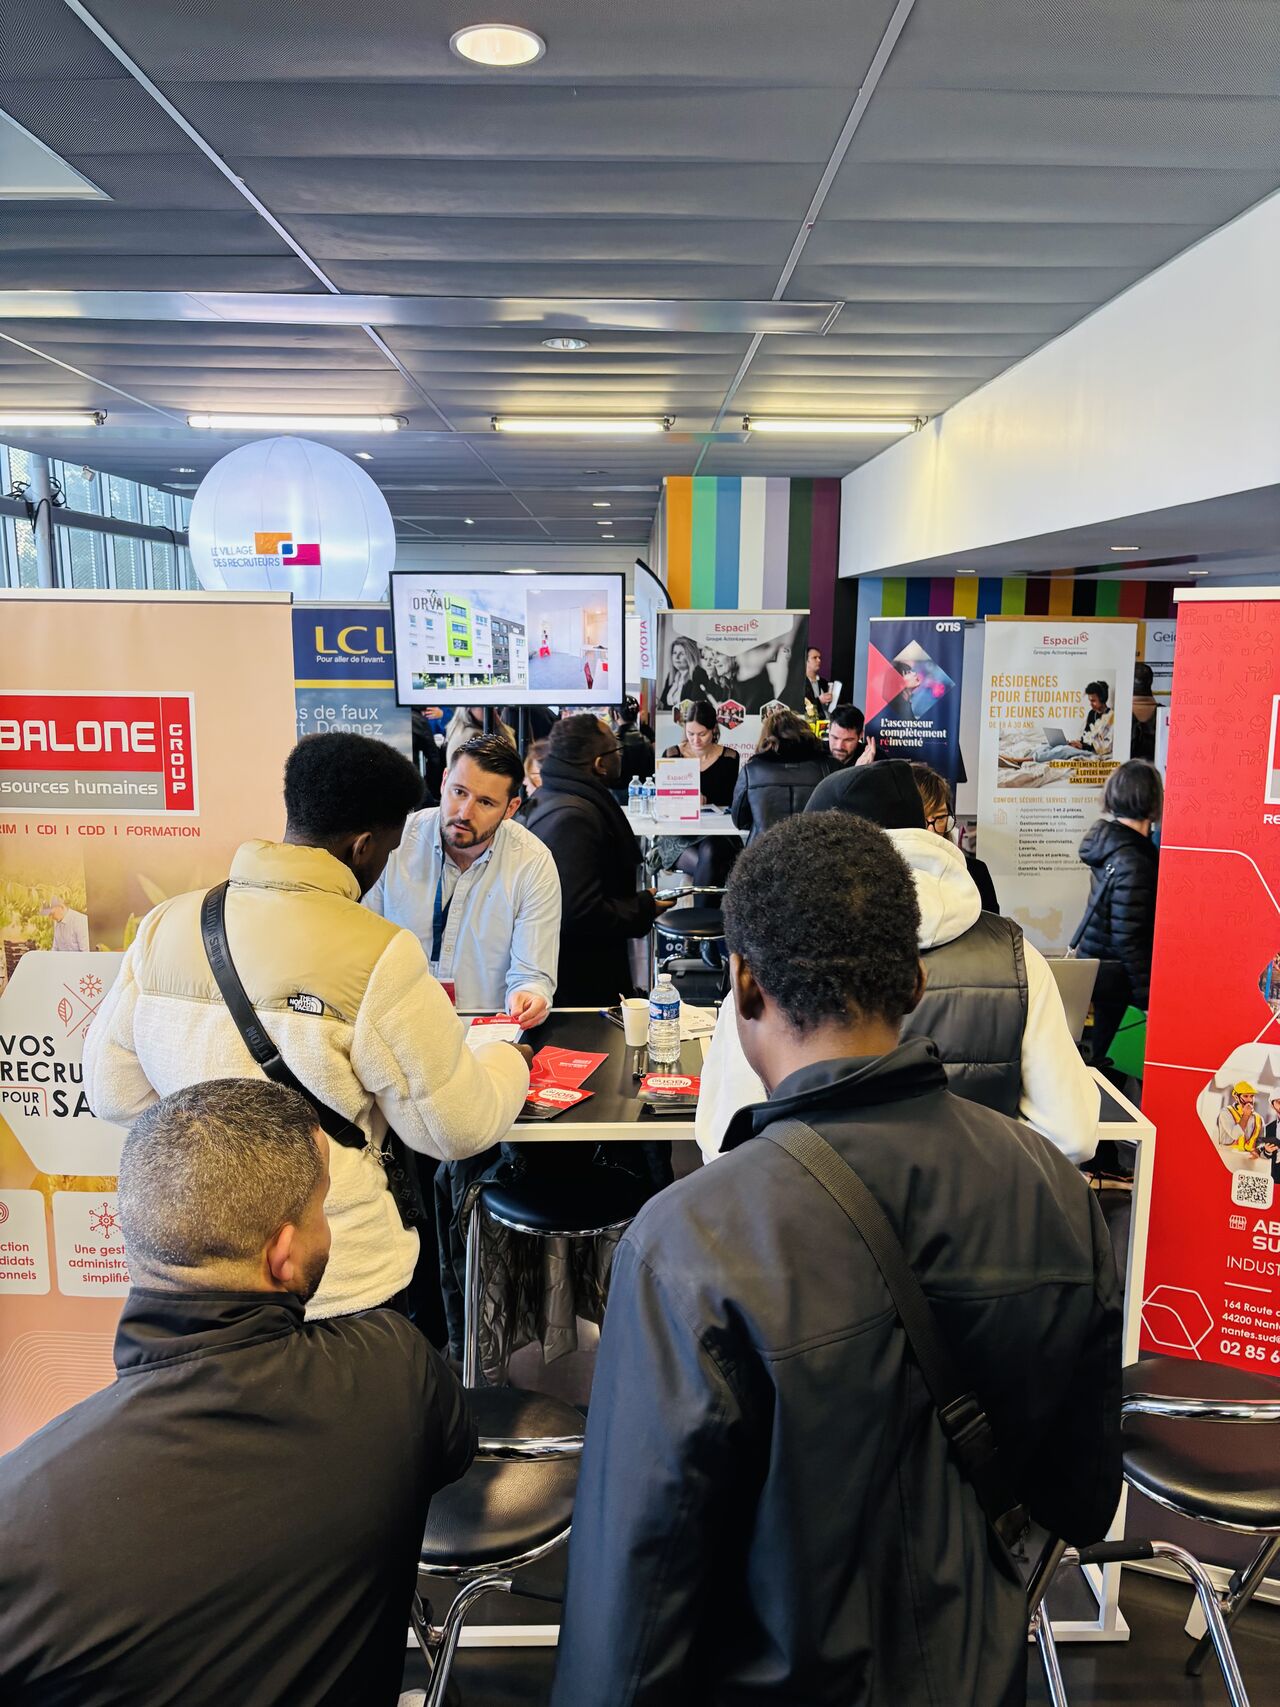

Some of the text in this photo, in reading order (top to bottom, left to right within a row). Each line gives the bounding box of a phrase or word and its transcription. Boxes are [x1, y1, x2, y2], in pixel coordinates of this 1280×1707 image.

[220, 546, 254, 556] VILLAGE
[213, 557, 280, 568] DES RECRUTEURS
[413, 597, 451, 610] ORVAU
[714, 623, 749, 633] Espacil
[936, 622, 961, 632] OTIS
[315, 626, 394, 655] LCL
[640, 620, 650, 670] TOYOTA
[1043, 636, 1079, 646] Espacil
[316, 655, 333, 663] Pour
[334, 655, 349, 663] aller
[991, 673, 1058, 688] RÉSIDENCES
[990, 688, 1082, 703] POUR ÉTUDIANTS
[313, 704, 336, 720] de
[341, 704, 378, 720] faux
[989, 705, 1085, 719] ET JEUNES ACTIFS
[317, 721, 384, 736] Donnez
[880, 718, 934, 728] L'ascenseur
[0, 720, 156, 752] BALONE
[879, 728, 947, 739] complètement
[879, 737, 924, 747] réinventé
[168, 723, 187, 794] GROUP
[0, 780, 158, 795] sources humaines
[37, 825, 57, 835] CDI
[78, 826, 105, 836] CDD
[126, 825, 201, 837] FORMATION
[289, 998, 311, 1007] NORTH
[294, 1004, 313, 1012] FACE
[0, 1034, 56, 1058] VOS
[0, 1061, 84, 1084] RECRU
[2, 1091, 40, 1104] POUR
[52, 1089, 97, 1118] SA
[24, 1105, 41, 1117] LA
[1252, 1219, 1280, 1236] AB
[74, 1244, 96, 1254] Une
[1252, 1235, 1280, 1253] SU
[1226, 1255, 1280, 1277] INDUST
[1224, 1298, 1241, 1310] 164
[1243, 1302, 1273, 1316] Route
[1222, 1312, 1280, 1331] 44200 Nant
[1220, 1339, 1241, 1356] 02
[1244, 1344, 1266, 1361] 85
